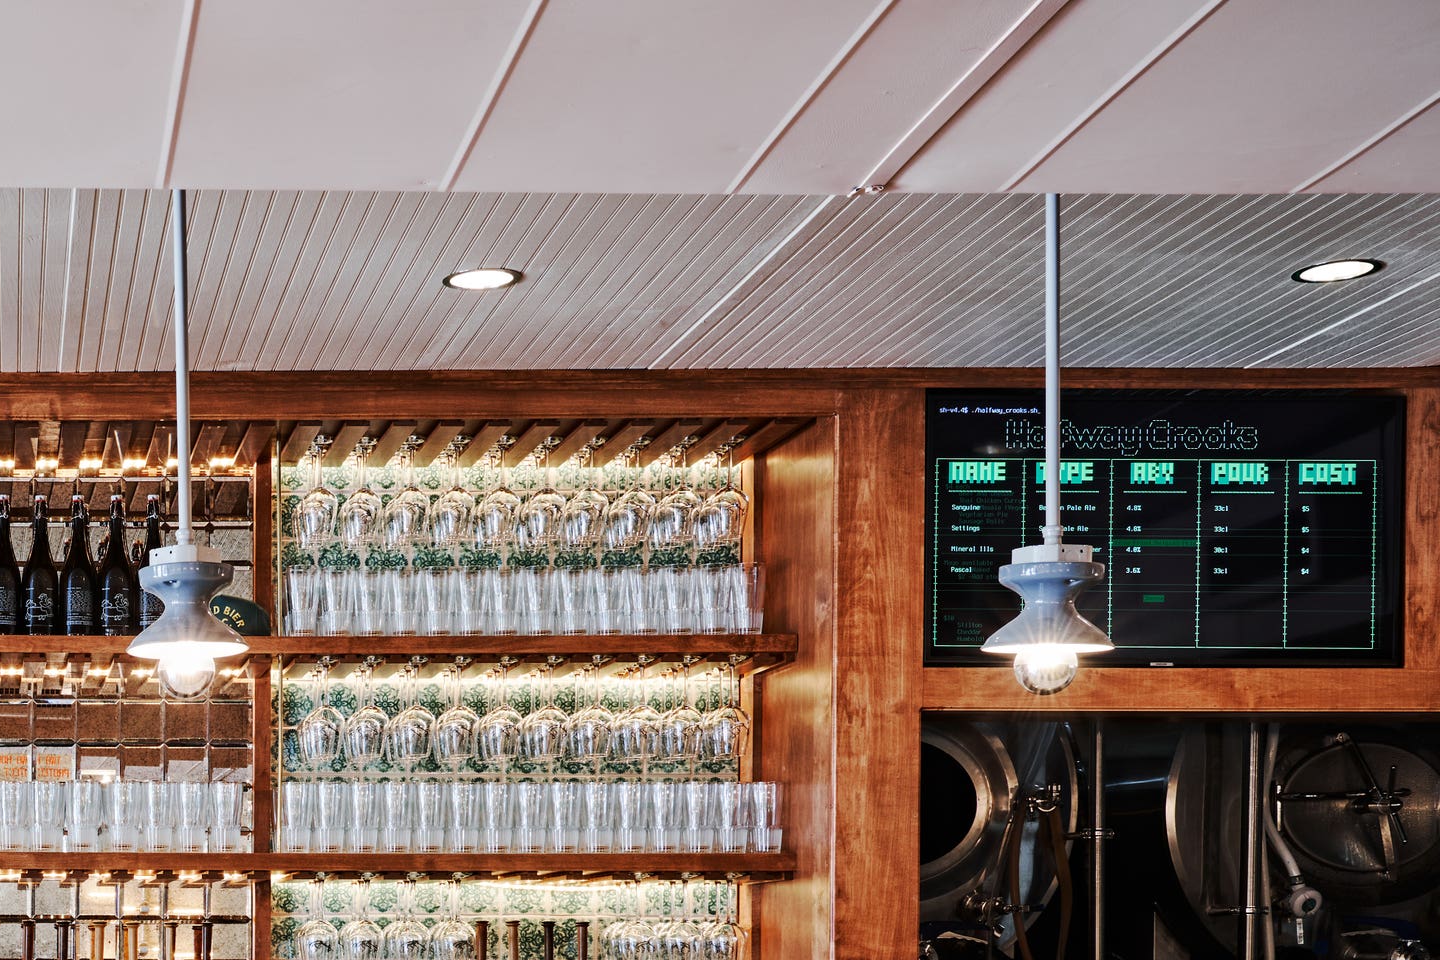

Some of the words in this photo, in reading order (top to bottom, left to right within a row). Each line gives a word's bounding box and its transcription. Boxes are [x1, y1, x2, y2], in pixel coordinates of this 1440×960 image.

[1006, 419, 1141, 456] Hafway
[949, 462, 1006, 483] NAME
[1036, 462, 1093, 484] TPE
[1131, 462, 1174, 484] ABV
[1211, 463, 1269, 484] POUR
[1299, 463, 1357, 485] COST
[223, 606, 245, 628] BIER
